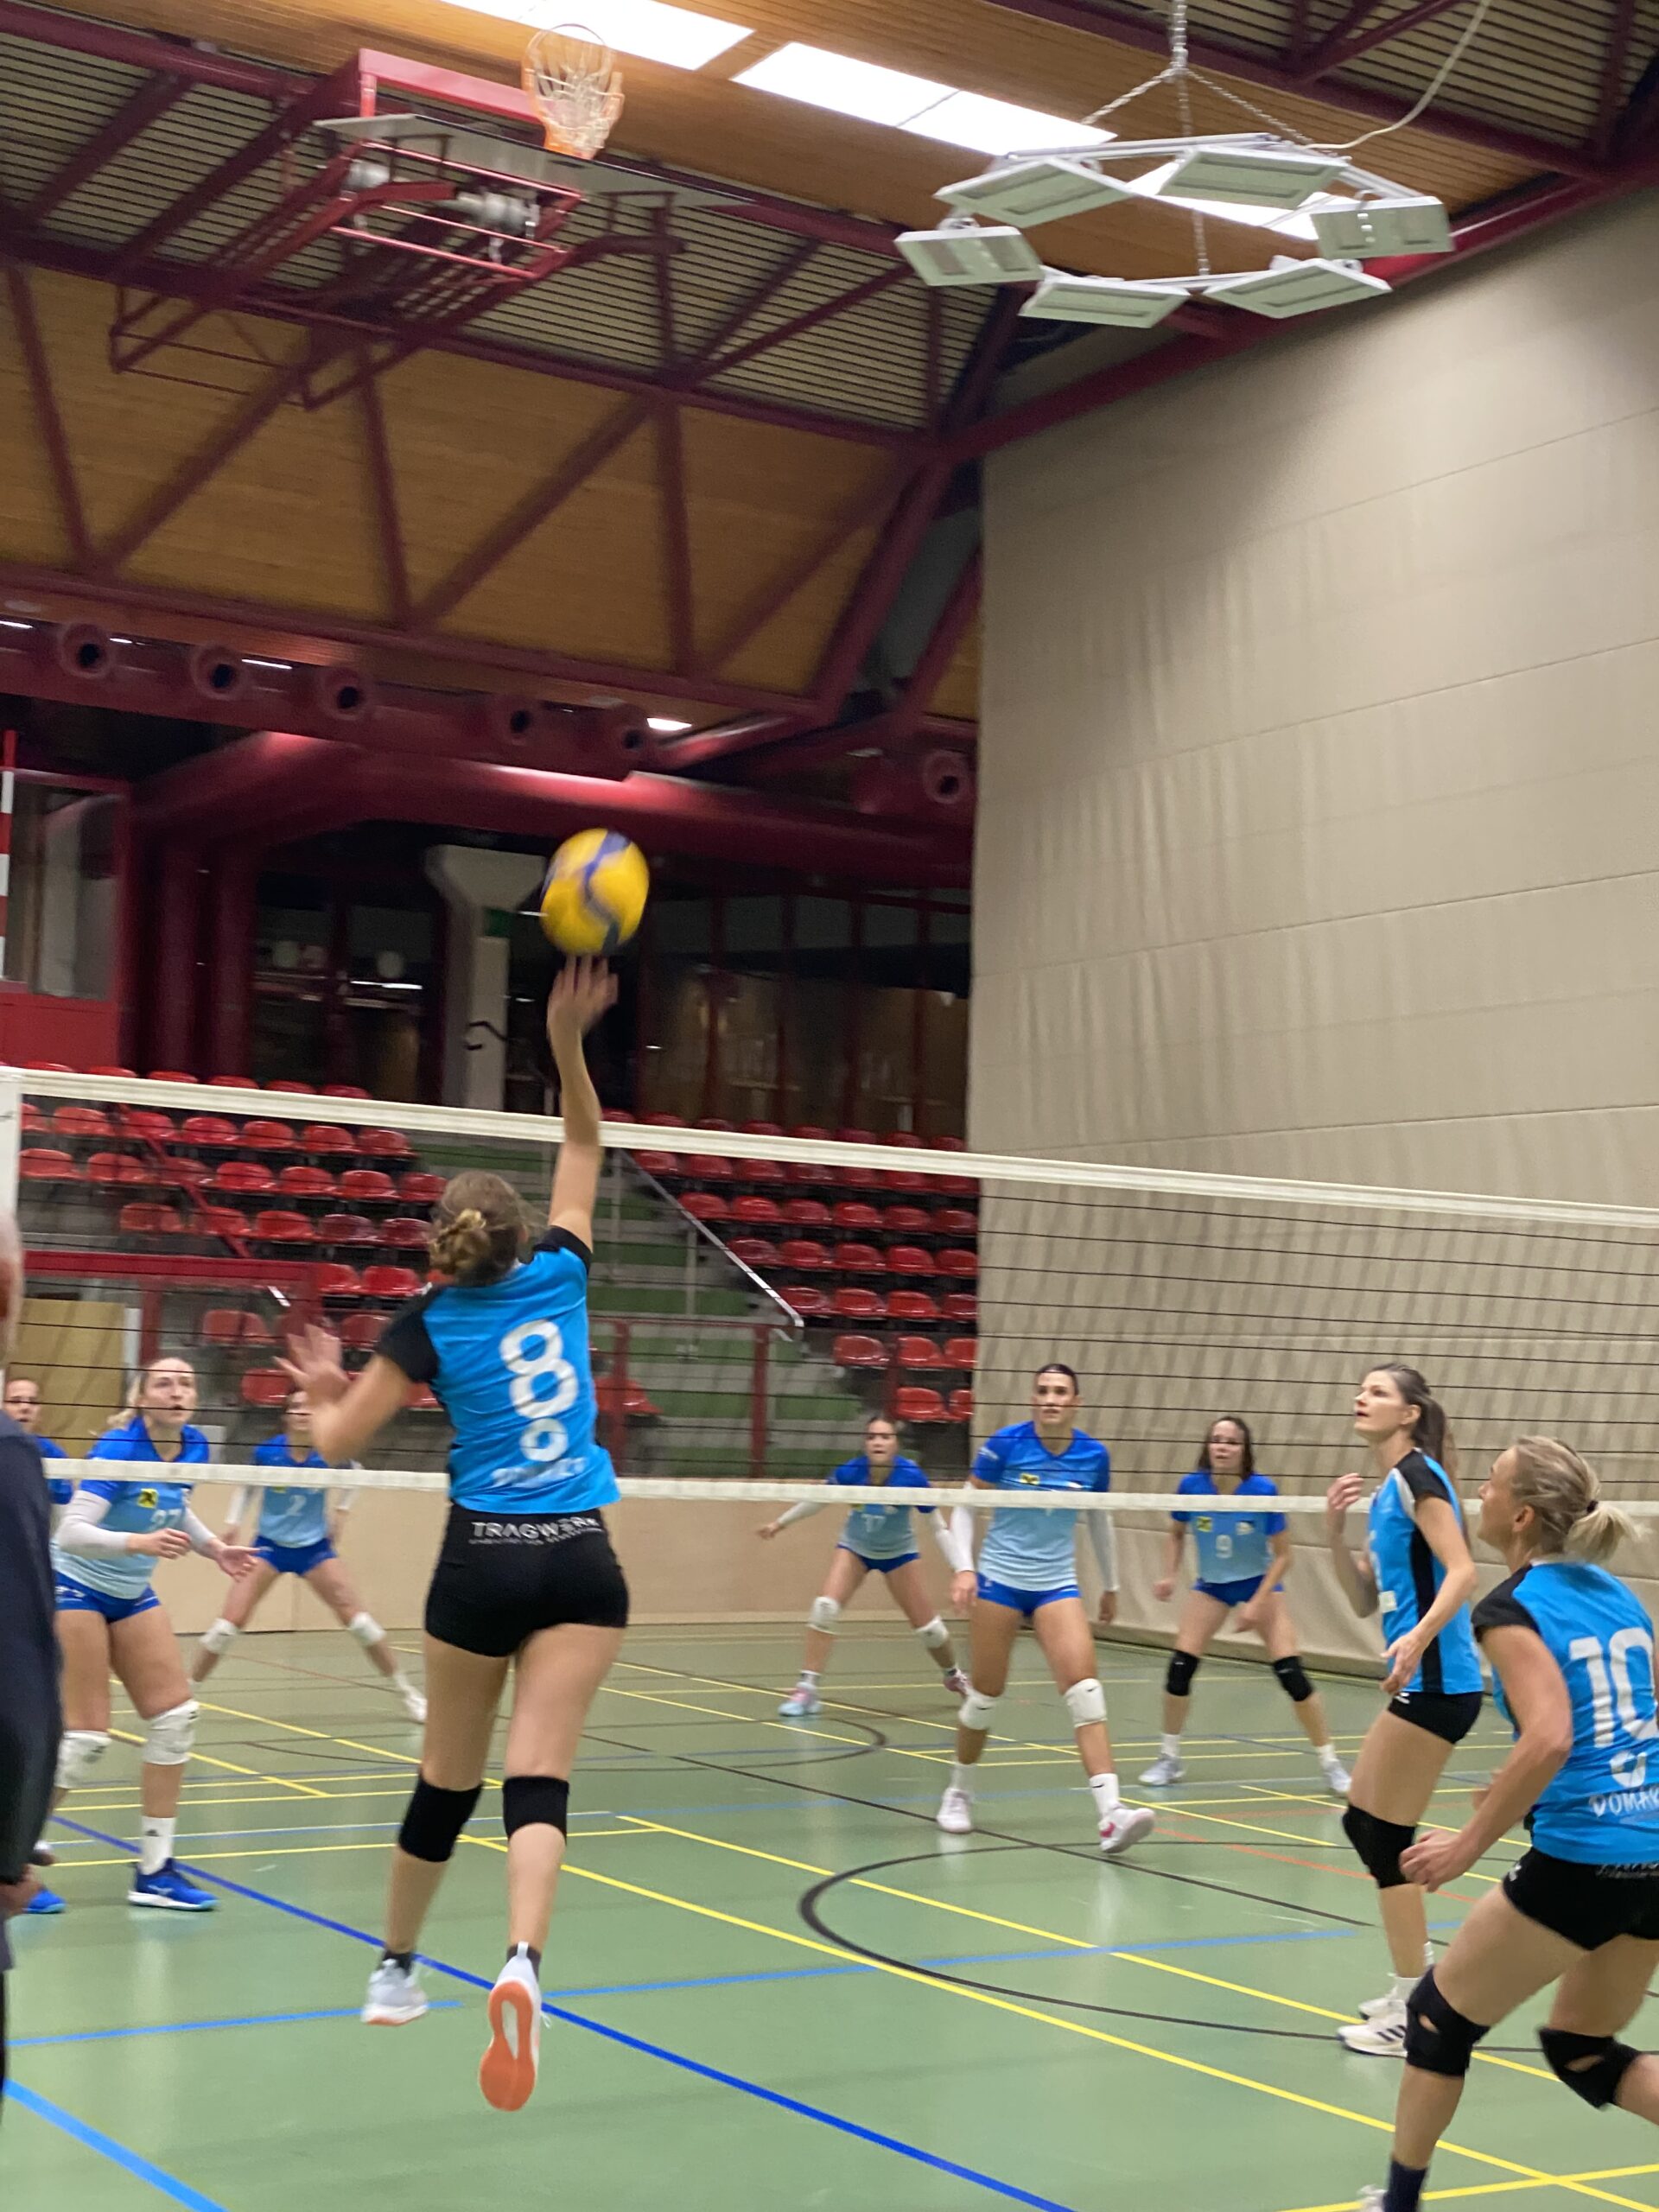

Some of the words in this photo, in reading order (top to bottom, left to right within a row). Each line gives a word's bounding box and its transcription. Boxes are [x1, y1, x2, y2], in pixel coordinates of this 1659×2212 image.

[499, 1319, 579, 1419] 8
[286, 1495, 306, 1516] 2
[1215, 1534, 1233, 1559] 9
[1569, 1627, 1658, 1748] 10
